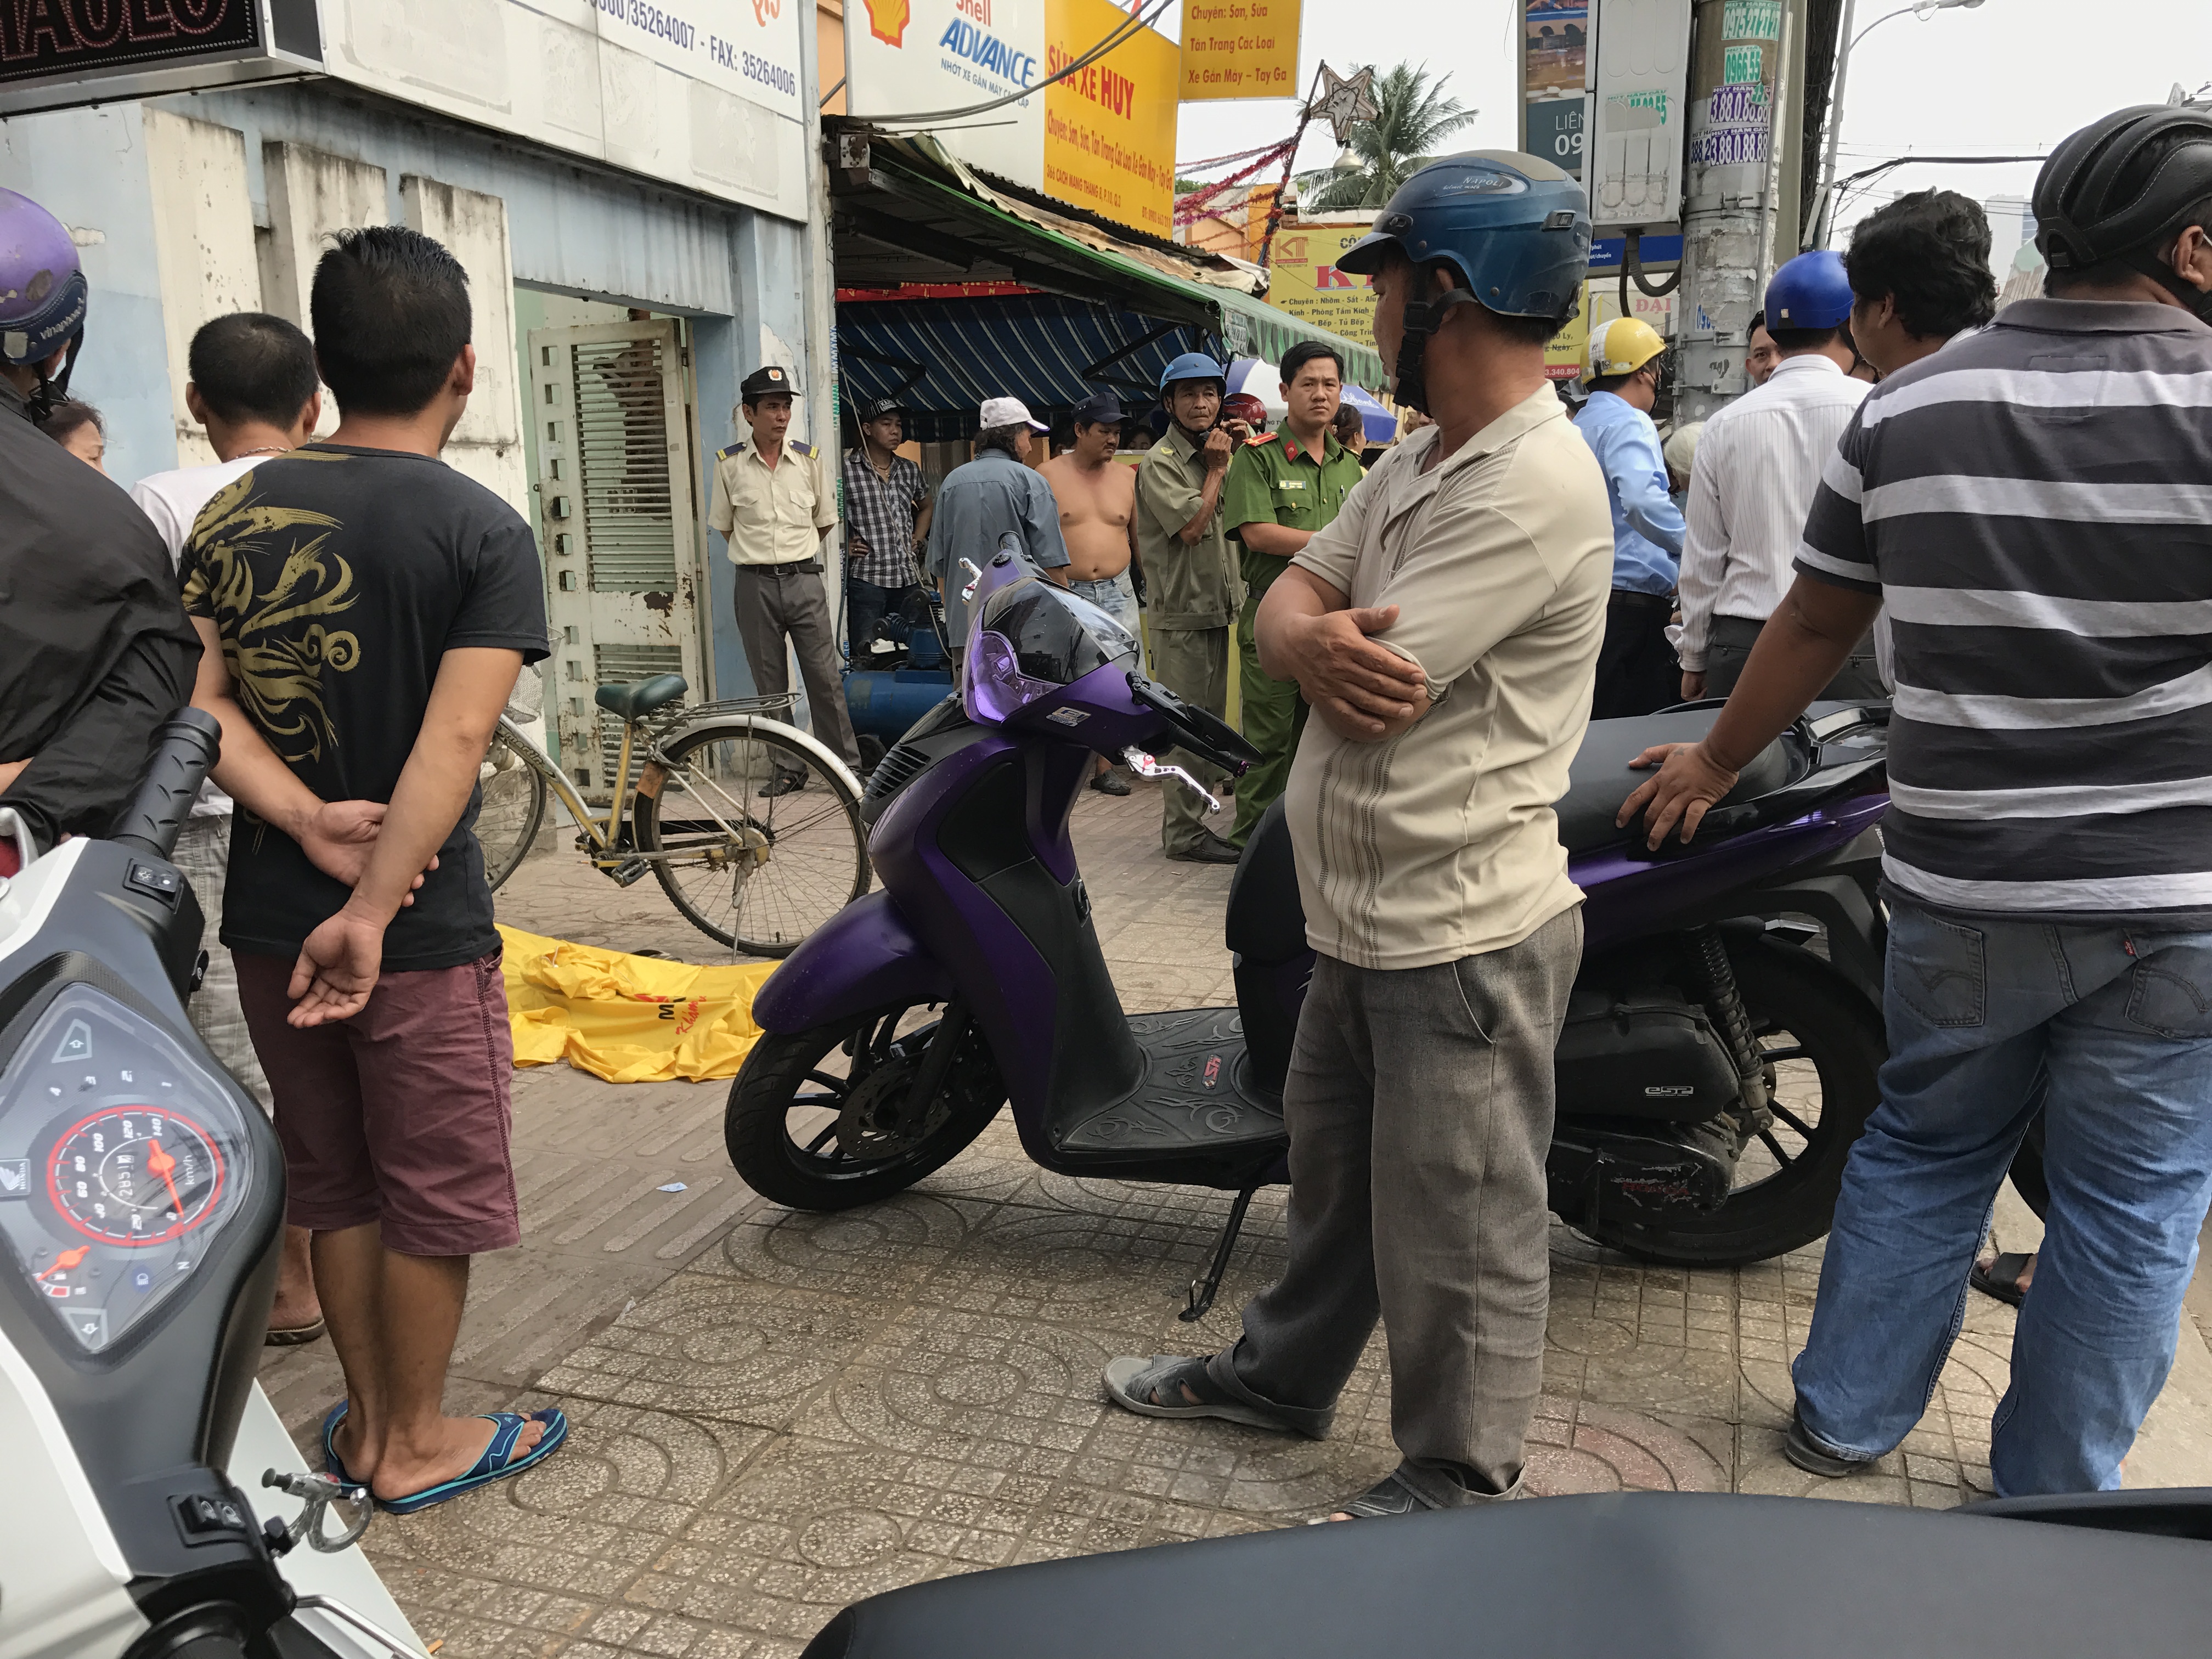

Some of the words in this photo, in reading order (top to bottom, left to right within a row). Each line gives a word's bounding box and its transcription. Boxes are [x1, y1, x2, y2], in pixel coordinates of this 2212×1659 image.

[1191, 5, 1226, 23] Chuyên:
[1229, 4, 1248, 21] Sơn,
[1251, 3, 1268, 18] Sửa
[938, 17, 1036, 89] ADVANCE
[1190, 37, 1206, 52] Tân
[1209, 37, 1235, 54] Trang
[1238, 36, 1254, 50] Các
[1256, 35, 1275, 52] Loại
[710, 35, 738, 71] FAX:
[742, 50, 795, 97] 35264006
[962, 68, 970, 82] XE
[1188, 69, 1200, 84] Xe
[1203, 67, 1221, 83] Gắn
[1223, 68, 1243, 86] Máy
[1255, 67, 1271, 86] Tay
[1273, 66, 1287, 81] Ga
[1080, 65, 1096, 102] XE
[1101, 65, 1135, 121] HUY
[1711, 133, 1768, 166] 3.88.0.88.88
[1463, 177, 1504, 187] NAPOLI
[1289, 298, 1314, 306] Chuyên
[1635, 298, 1672, 315] ĐẠI
[1289, 308, 1305, 317] Kính
[1311, 308, 1334, 316] Phòng
[1318, 319, 1332, 327] Bếp
[1350, 318, 1364, 326] Bếp
[49, 1087, 61, 1096] 4
[122, 1120, 134, 1139] 120
[151, 1118, 163, 1137] 140
[93, 1133, 105, 1153] 100
[74, 1155, 86, 1172] 80
[183, 1154, 195, 1186] km/h
[76, 1181, 88, 1198] 60
[131, 1214, 143, 1231] 20
[177, 1261, 190, 1270] N
